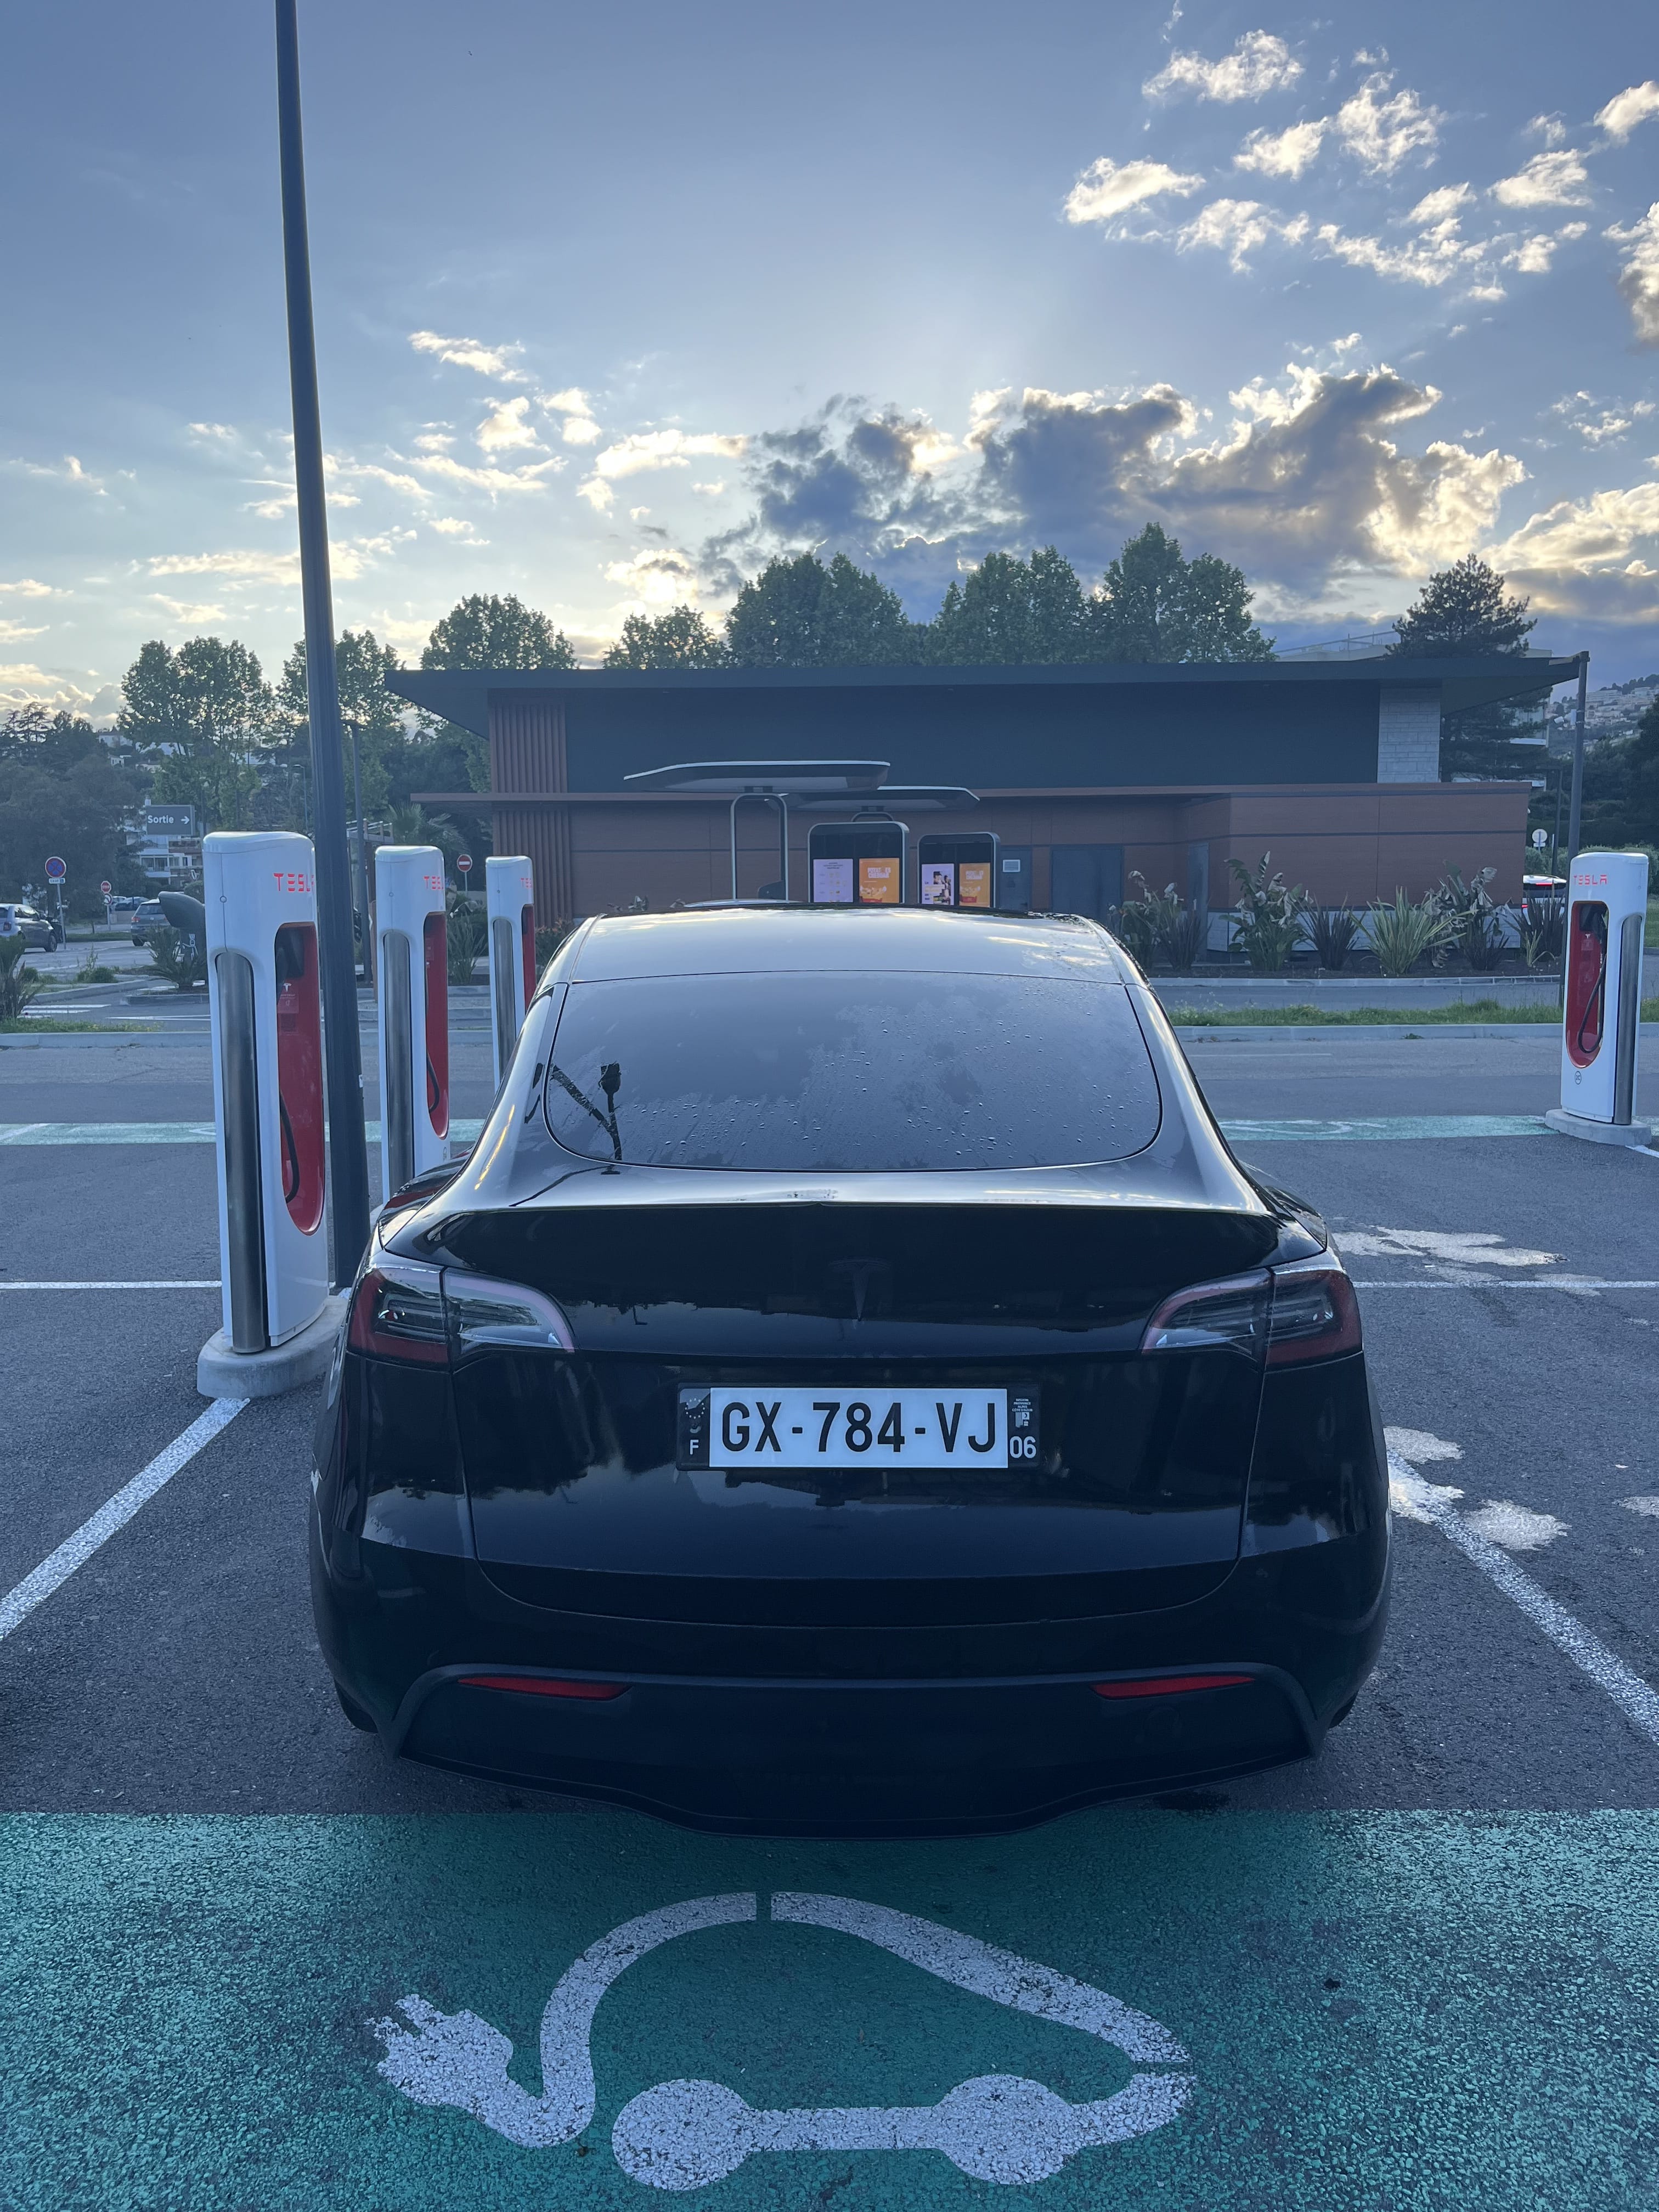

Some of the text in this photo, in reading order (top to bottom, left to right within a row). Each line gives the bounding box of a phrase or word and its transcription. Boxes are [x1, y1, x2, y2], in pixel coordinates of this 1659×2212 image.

[148, 815, 174, 823] Sortie
[1573, 874, 1607, 885] TESLA
[722, 1402, 996, 1453] GX-784-VJ
[690, 1439, 699, 1455] F
[1009, 1436, 1036, 1458] 06
